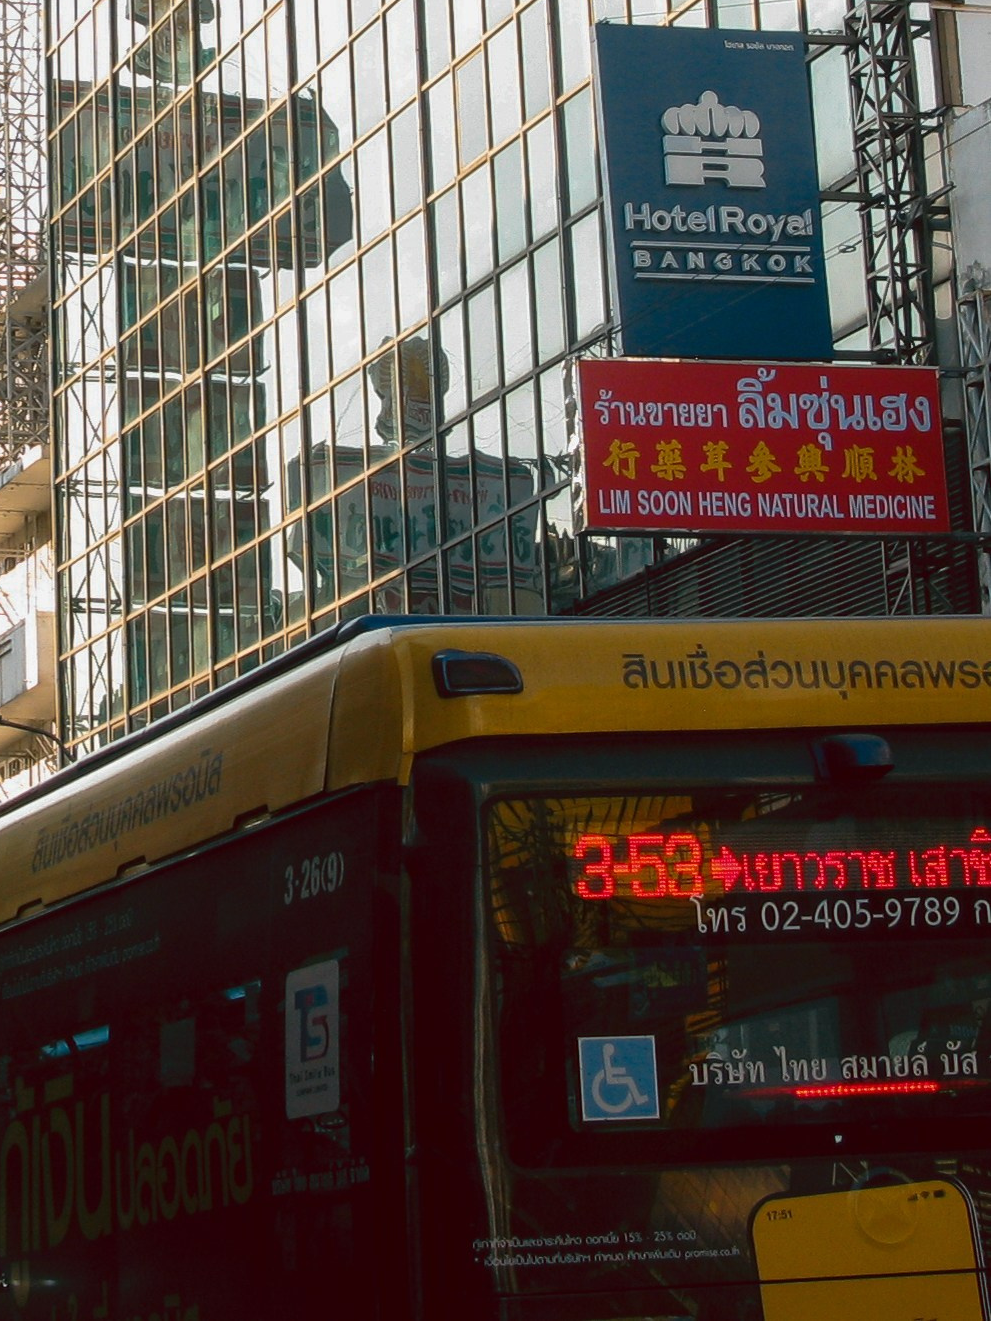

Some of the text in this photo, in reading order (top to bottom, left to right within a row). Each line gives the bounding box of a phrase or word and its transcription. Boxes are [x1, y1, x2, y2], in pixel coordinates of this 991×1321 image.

[623, 201, 813, 243] Hotel Royal
[632, 248, 814, 274] BANGKOK
[593, 367, 932, 451] ร้านขายยา ลิ้มซุ่นเฮง
[597, 488, 936, 521] LIM SOON HENG NATURAL MEDICINE
[573, 833, 705, 900] 3-53
[690, 893, 747, 933] โทร
[761, 896, 961, 931] 02-405-9789
[688, 1039, 979, 1087] บริษัท ไทย สมายล์ บัส
[766, 1208, 794, 1222] 17:51
